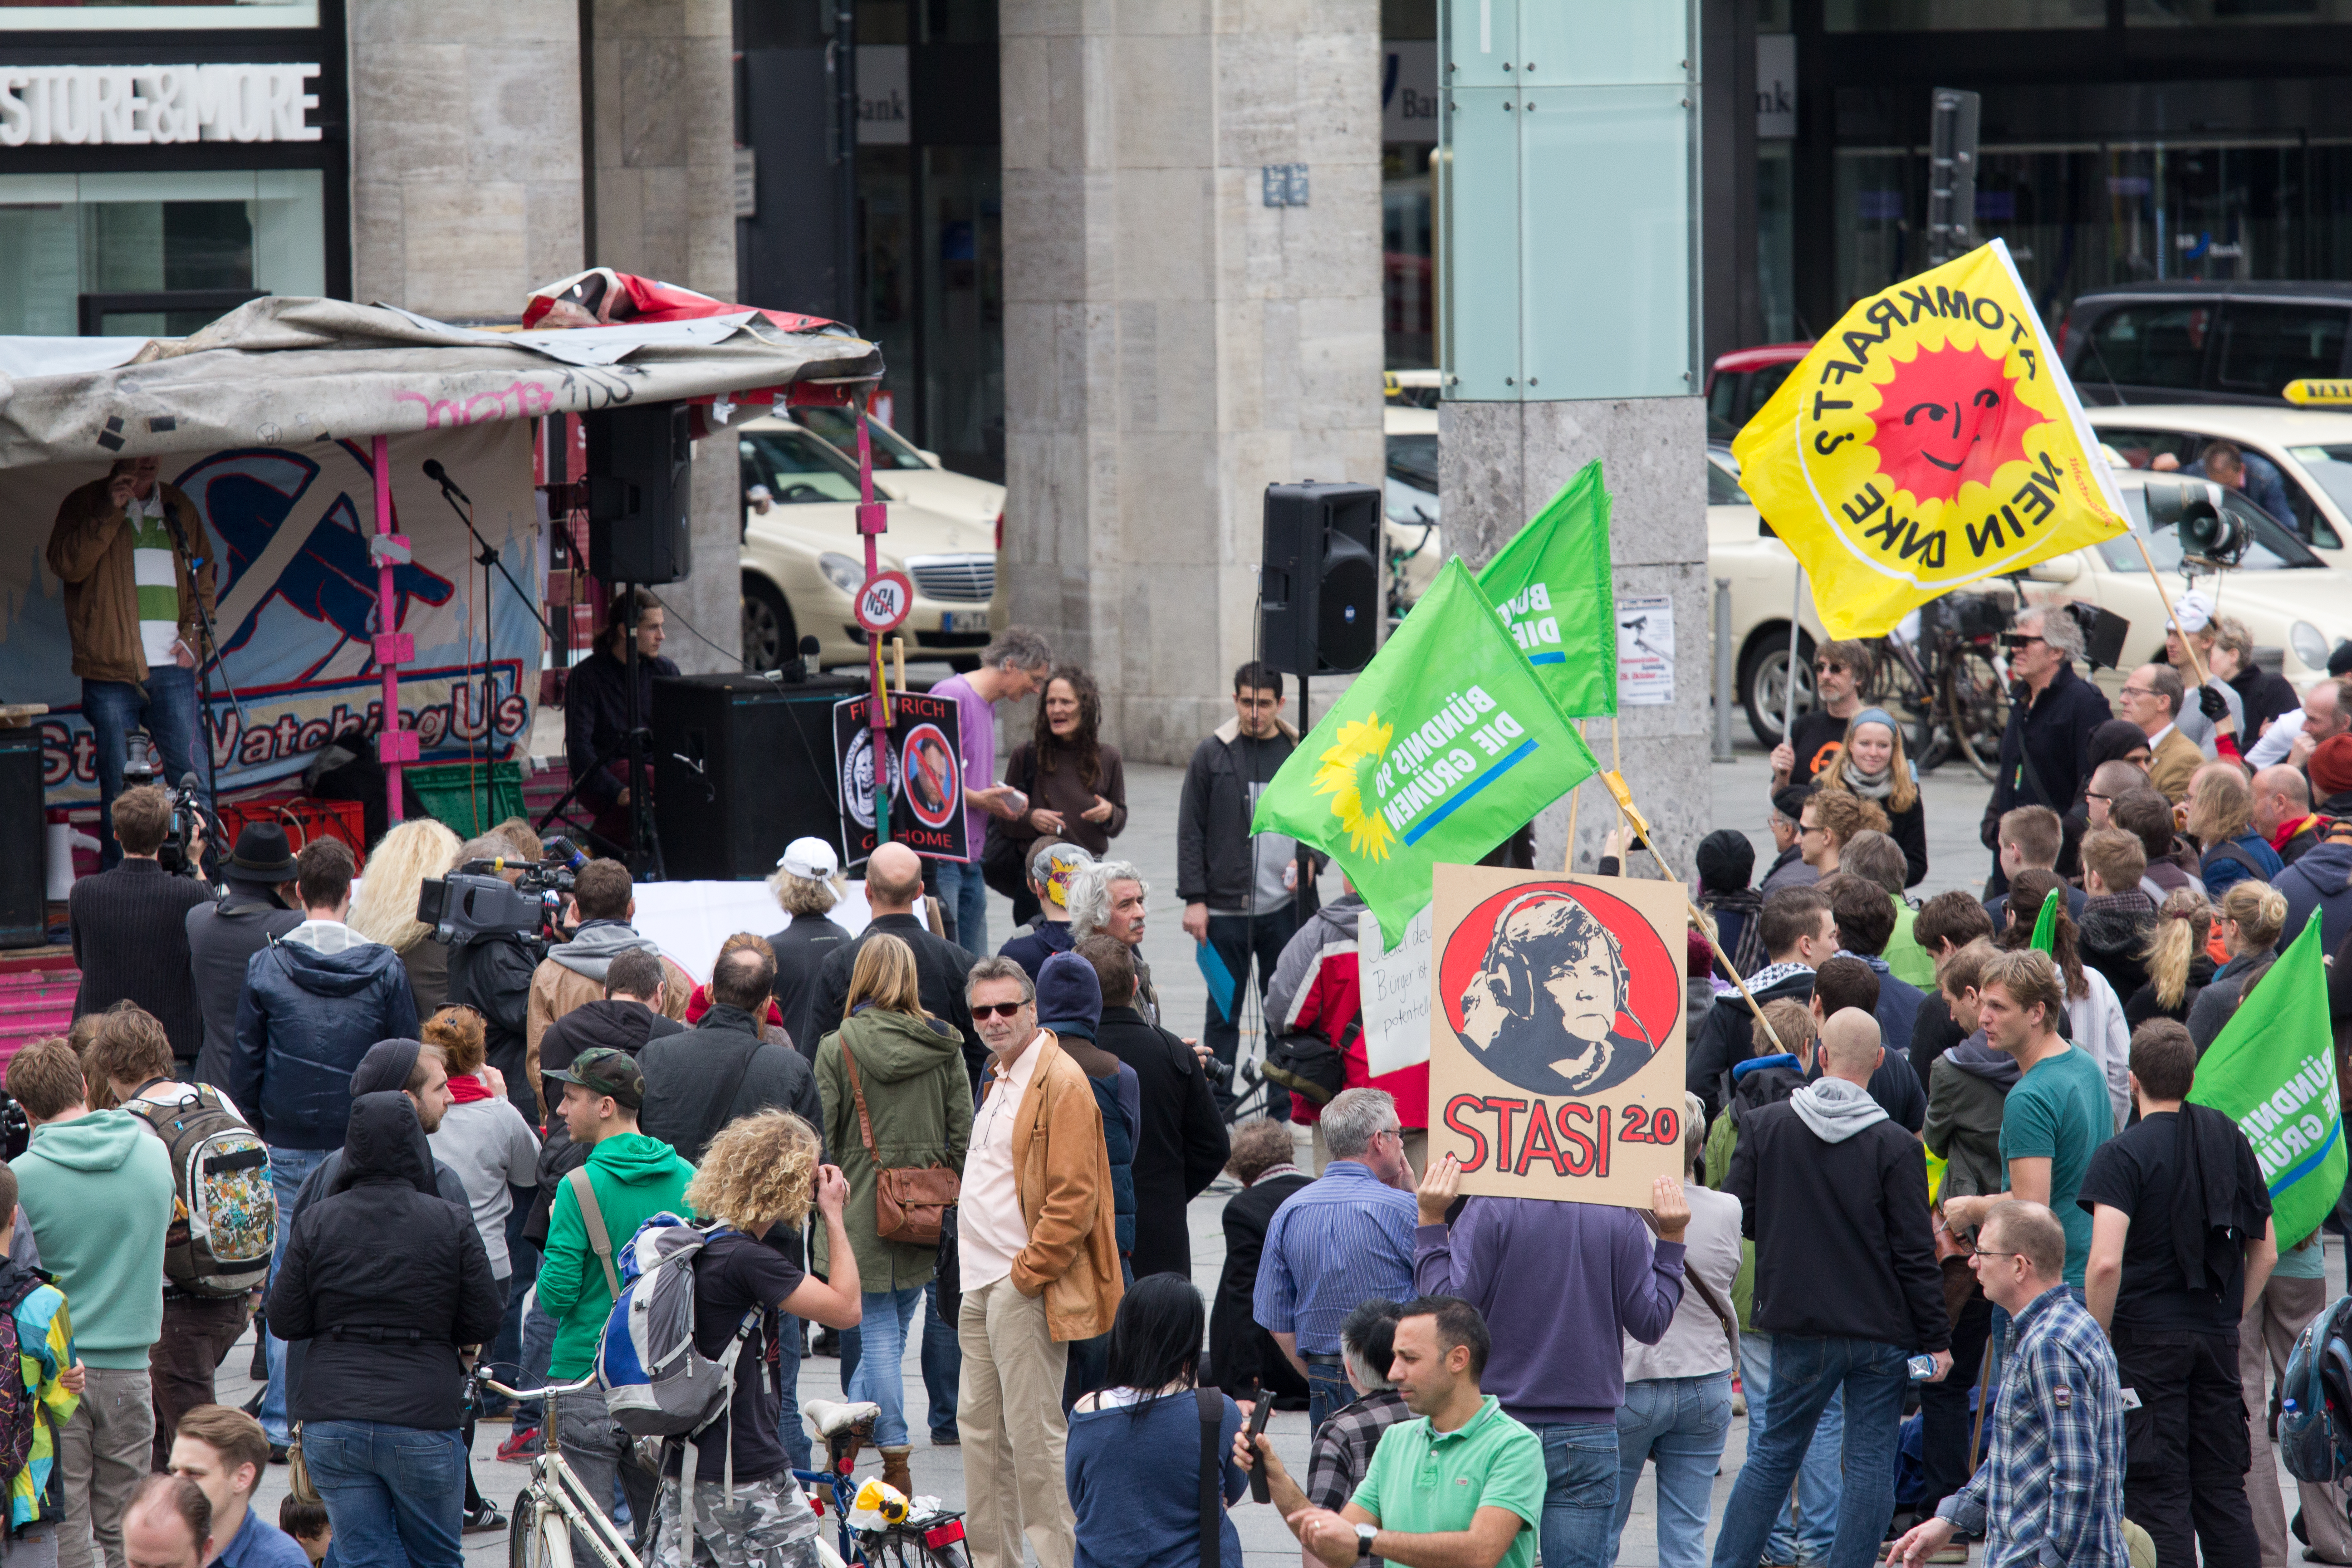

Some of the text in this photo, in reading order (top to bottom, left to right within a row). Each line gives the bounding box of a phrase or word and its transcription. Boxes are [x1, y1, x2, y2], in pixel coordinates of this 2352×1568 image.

[865, 588, 895, 616] NSA
[1372, 960, 1428, 1003] Bürger ist
[1443, 1093, 1680, 1177] STASI 2.0
